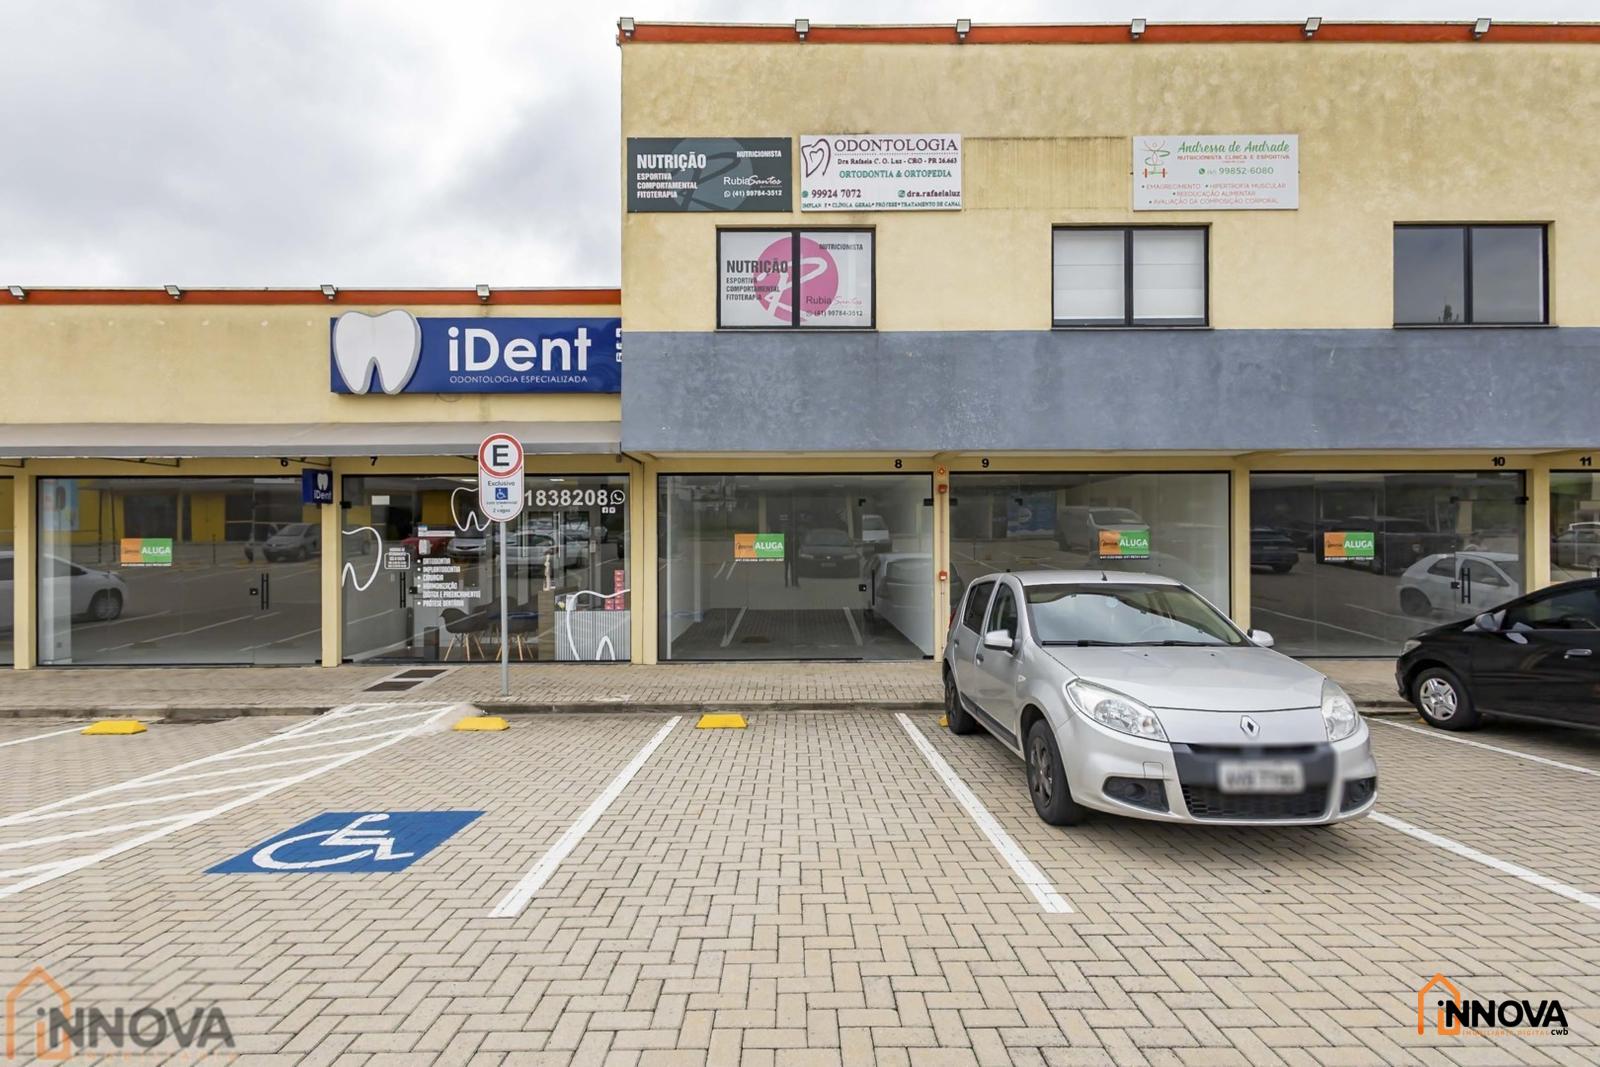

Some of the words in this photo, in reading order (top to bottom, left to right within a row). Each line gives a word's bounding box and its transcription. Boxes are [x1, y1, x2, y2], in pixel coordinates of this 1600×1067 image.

[834, 138, 959, 152] ODONTOLOGIA
[1177, 140, 1226, 153] Andressa
[1228, 140, 1241, 153] de
[1243, 139, 1290, 153] Andrade
[736, 150, 782, 158] NUTRICIONISTA
[636, 151, 707, 171] NUTRIÇÃO
[907, 157, 923, 165] CRO
[838, 170, 894, 179] ORTODONTIA
[895, 170, 902, 178] &
[903, 169, 952, 178] ORTOPEDIA
[1218, 167, 1247, 175] 99852
[1249, 166, 1274, 175] 6080
[636, 172, 673, 181] ESPORTIVA
[636, 181, 698, 190] COMPORTAMENTAL
[636, 190, 678, 199] FITOTERAPIA
[811, 189, 838, 199] 99924
[840, 189, 862, 198] 7072
[906, 189, 961, 198] dra.rafaelaluz
[726, 257, 788, 277] NUTRIÇÃO
[726, 285, 781, 293] COMPORTAMENTAL
[726, 293, 763, 301] FITOTERAPIA
[805, 295, 832, 305] Rubia
[447, 326, 592, 372] iDent
[450, 375, 519, 384] ODONTOLOGIA
[520, 375, 588, 383] ESPECIALIZADA
[492, 444, 510, 467] E
[280, 457, 289, 467] 6
[370, 456, 378, 466] 7
[894, 458, 903, 469] 8
[982, 458, 990, 468] 9
[1491, 456, 1506, 467] 10
[1579, 456, 1592, 466] 11
[754, 541, 784, 550] ALUGA
[1119, 538, 1149, 547] ALUGA
[1344, 540, 1373, 549] ALUGA
[142, 545, 172, 554] ALUGA
